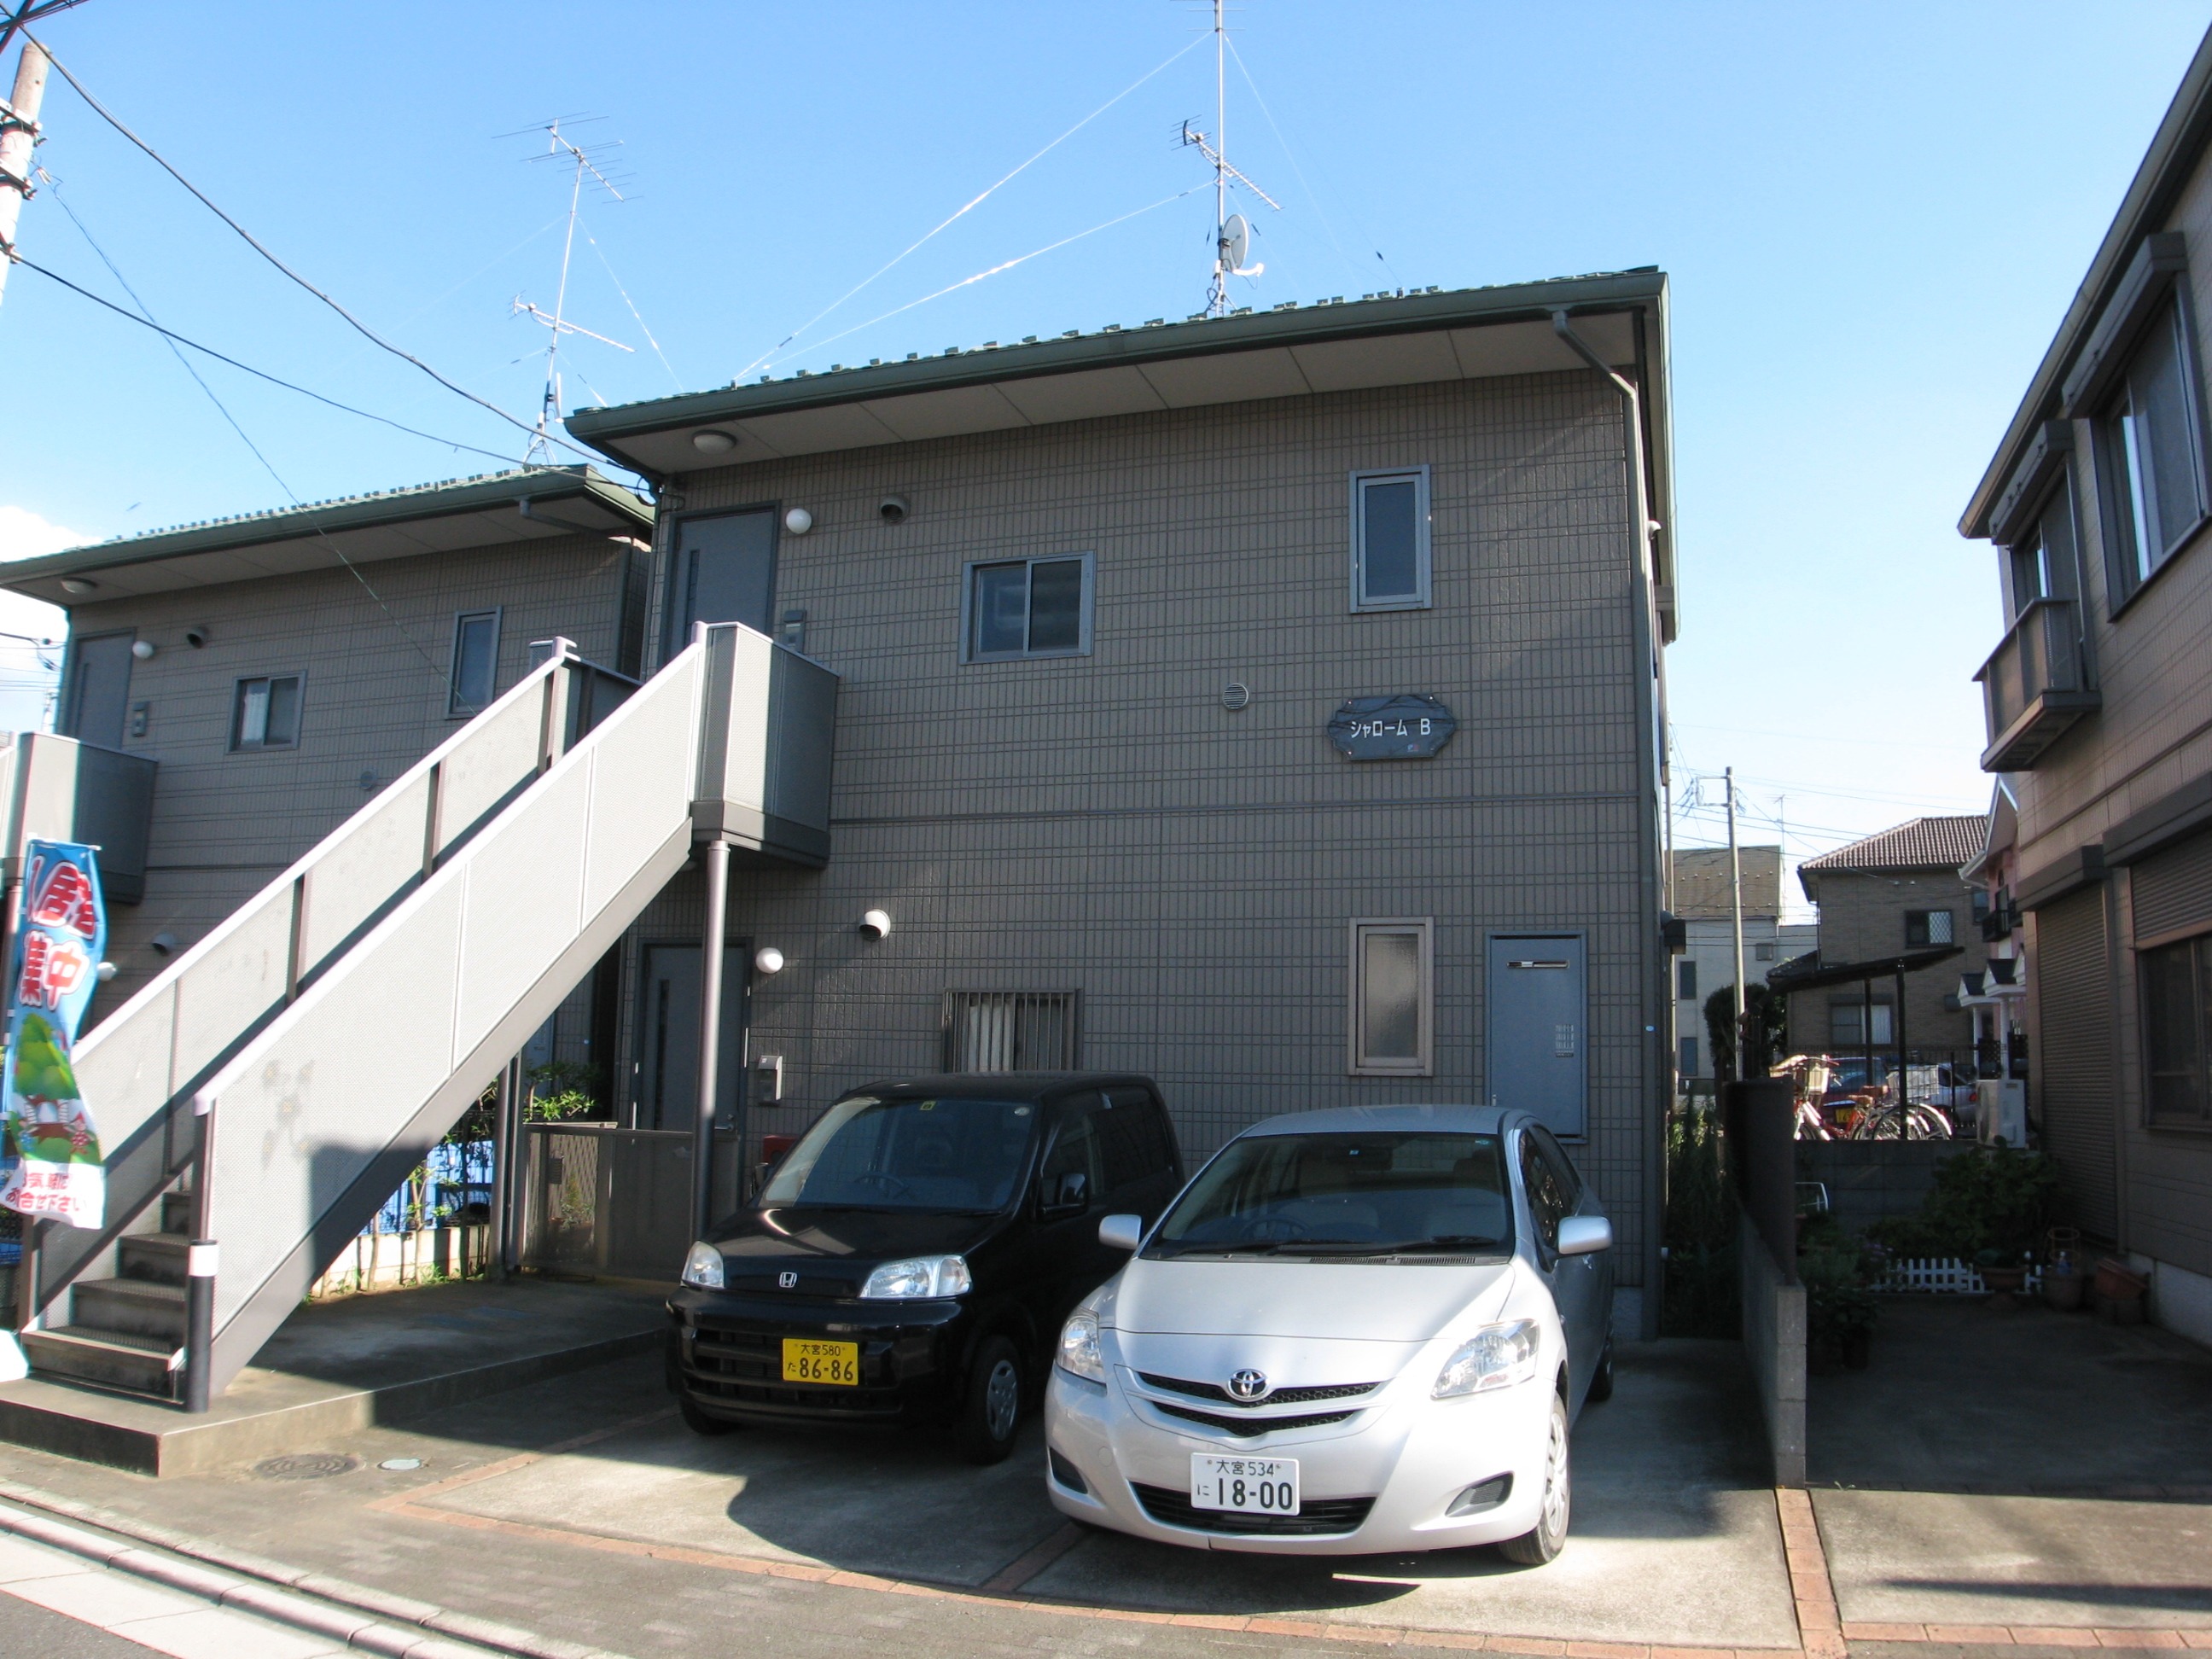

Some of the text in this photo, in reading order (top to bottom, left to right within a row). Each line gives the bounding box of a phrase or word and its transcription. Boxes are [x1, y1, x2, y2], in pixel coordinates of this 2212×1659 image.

[1350, 718, 1431, 739] シャローム B
[800, 1357, 853, 1382] 86-86
[1197, 1477, 1293, 1511] に 18-00
